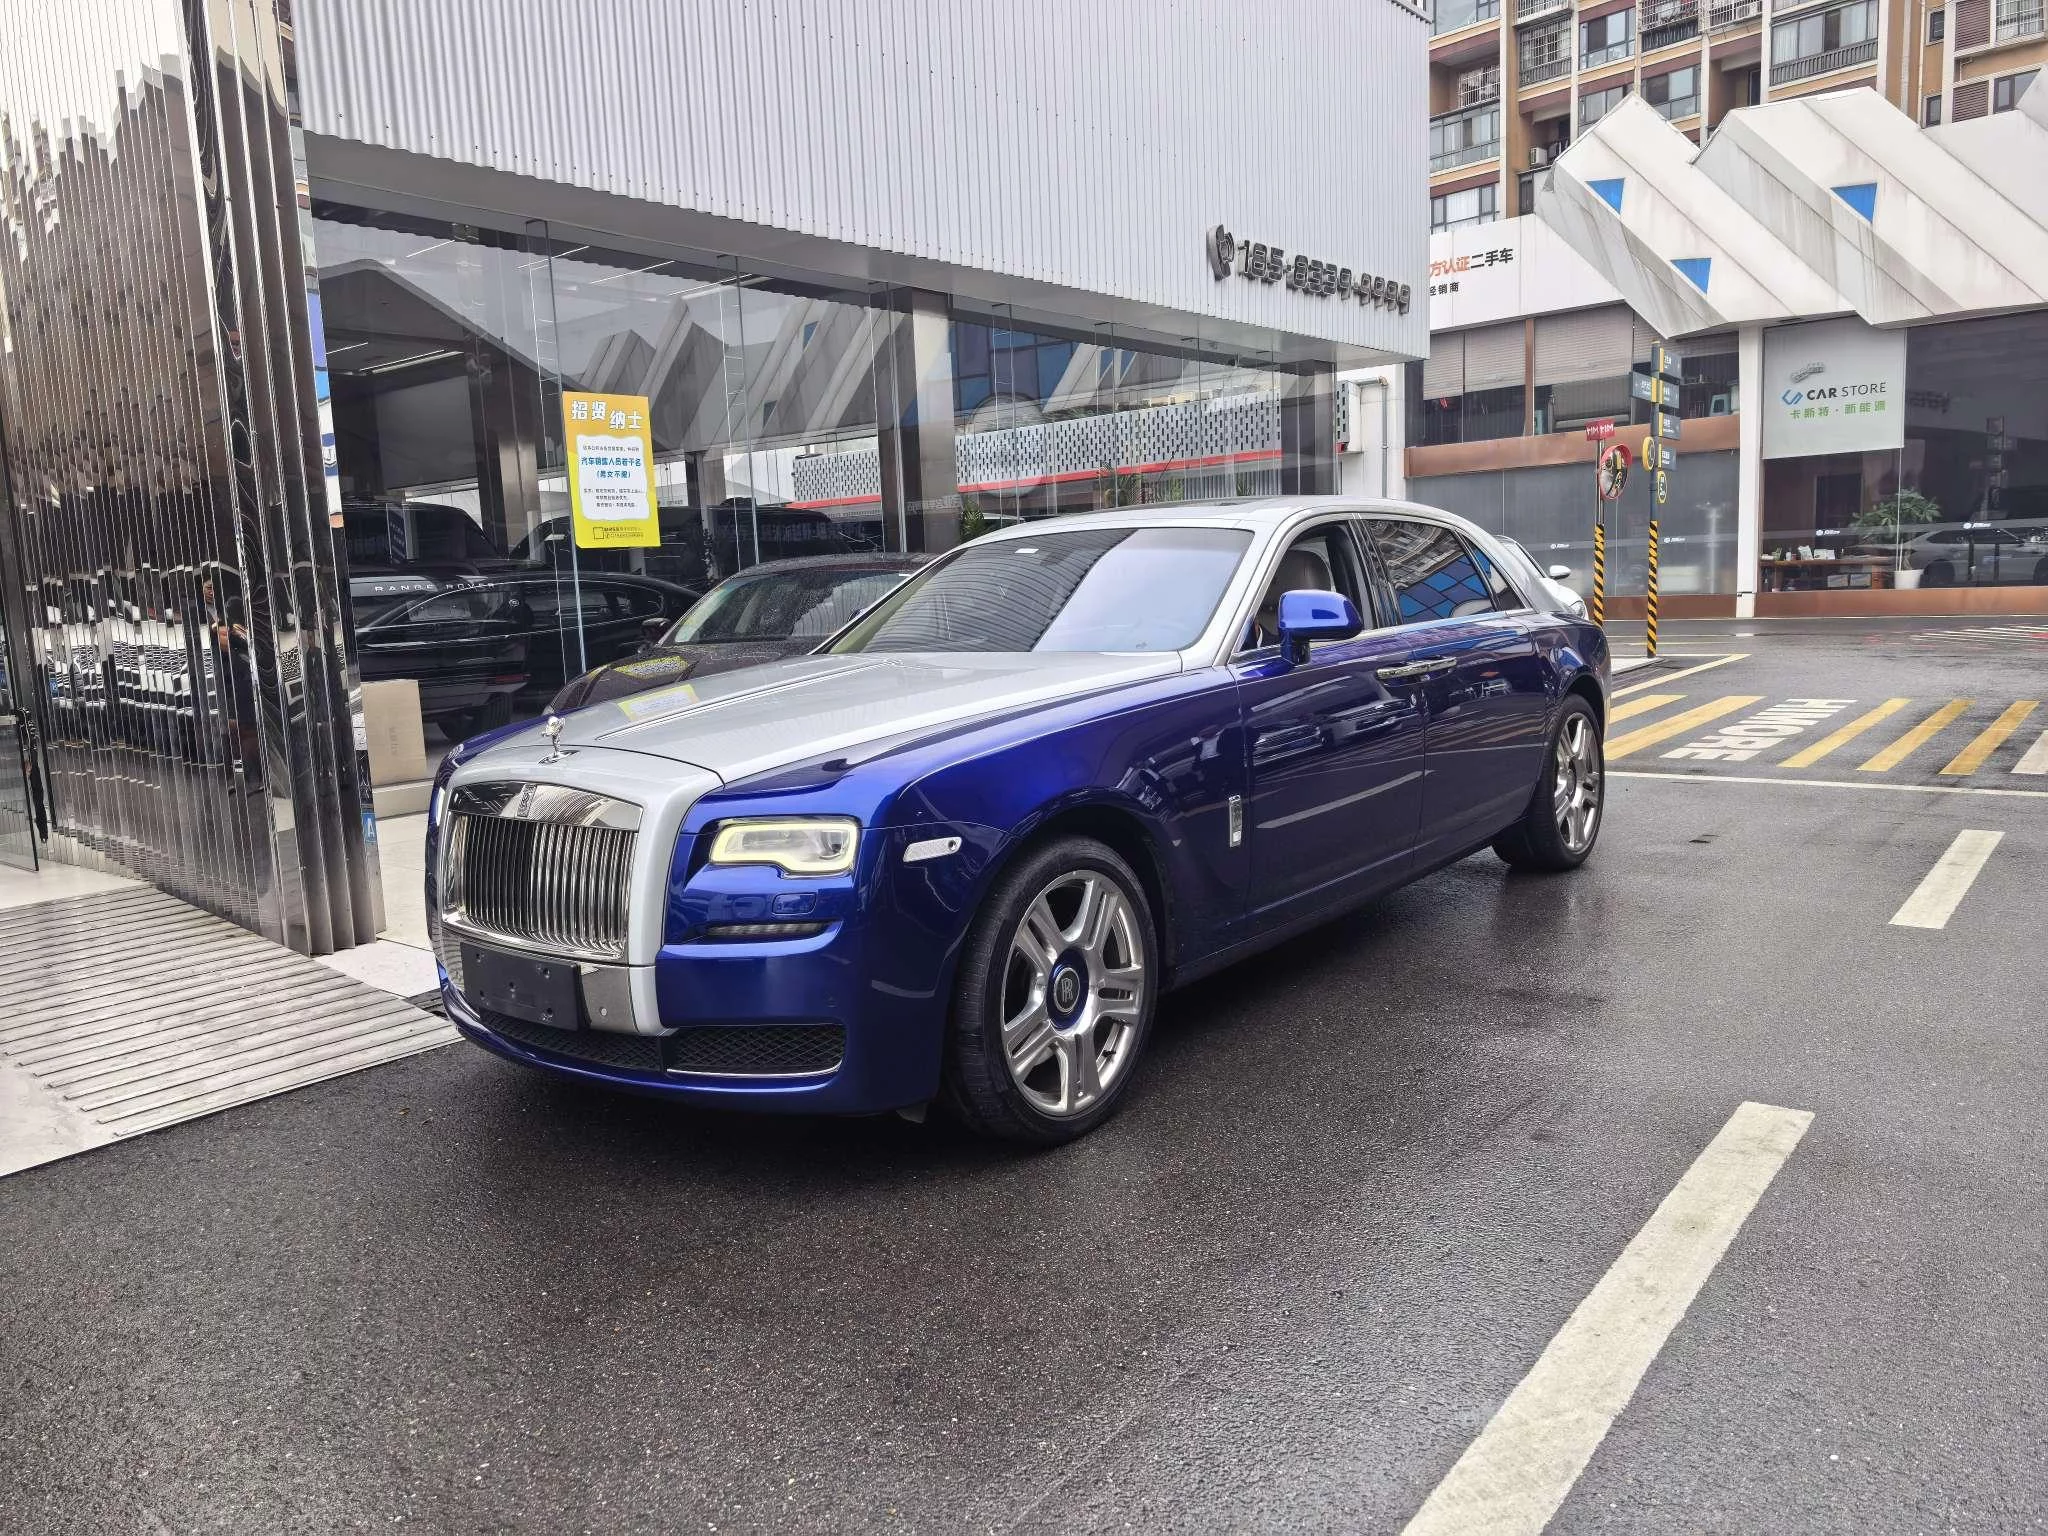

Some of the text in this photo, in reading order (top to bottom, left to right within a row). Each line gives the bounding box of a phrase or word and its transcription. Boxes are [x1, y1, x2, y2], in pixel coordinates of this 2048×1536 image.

[1806, 381, 1887, 400] CAR STORE
[374, 584, 435, 592] RANGE
[1658, 698, 1859, 761] HIMORE
